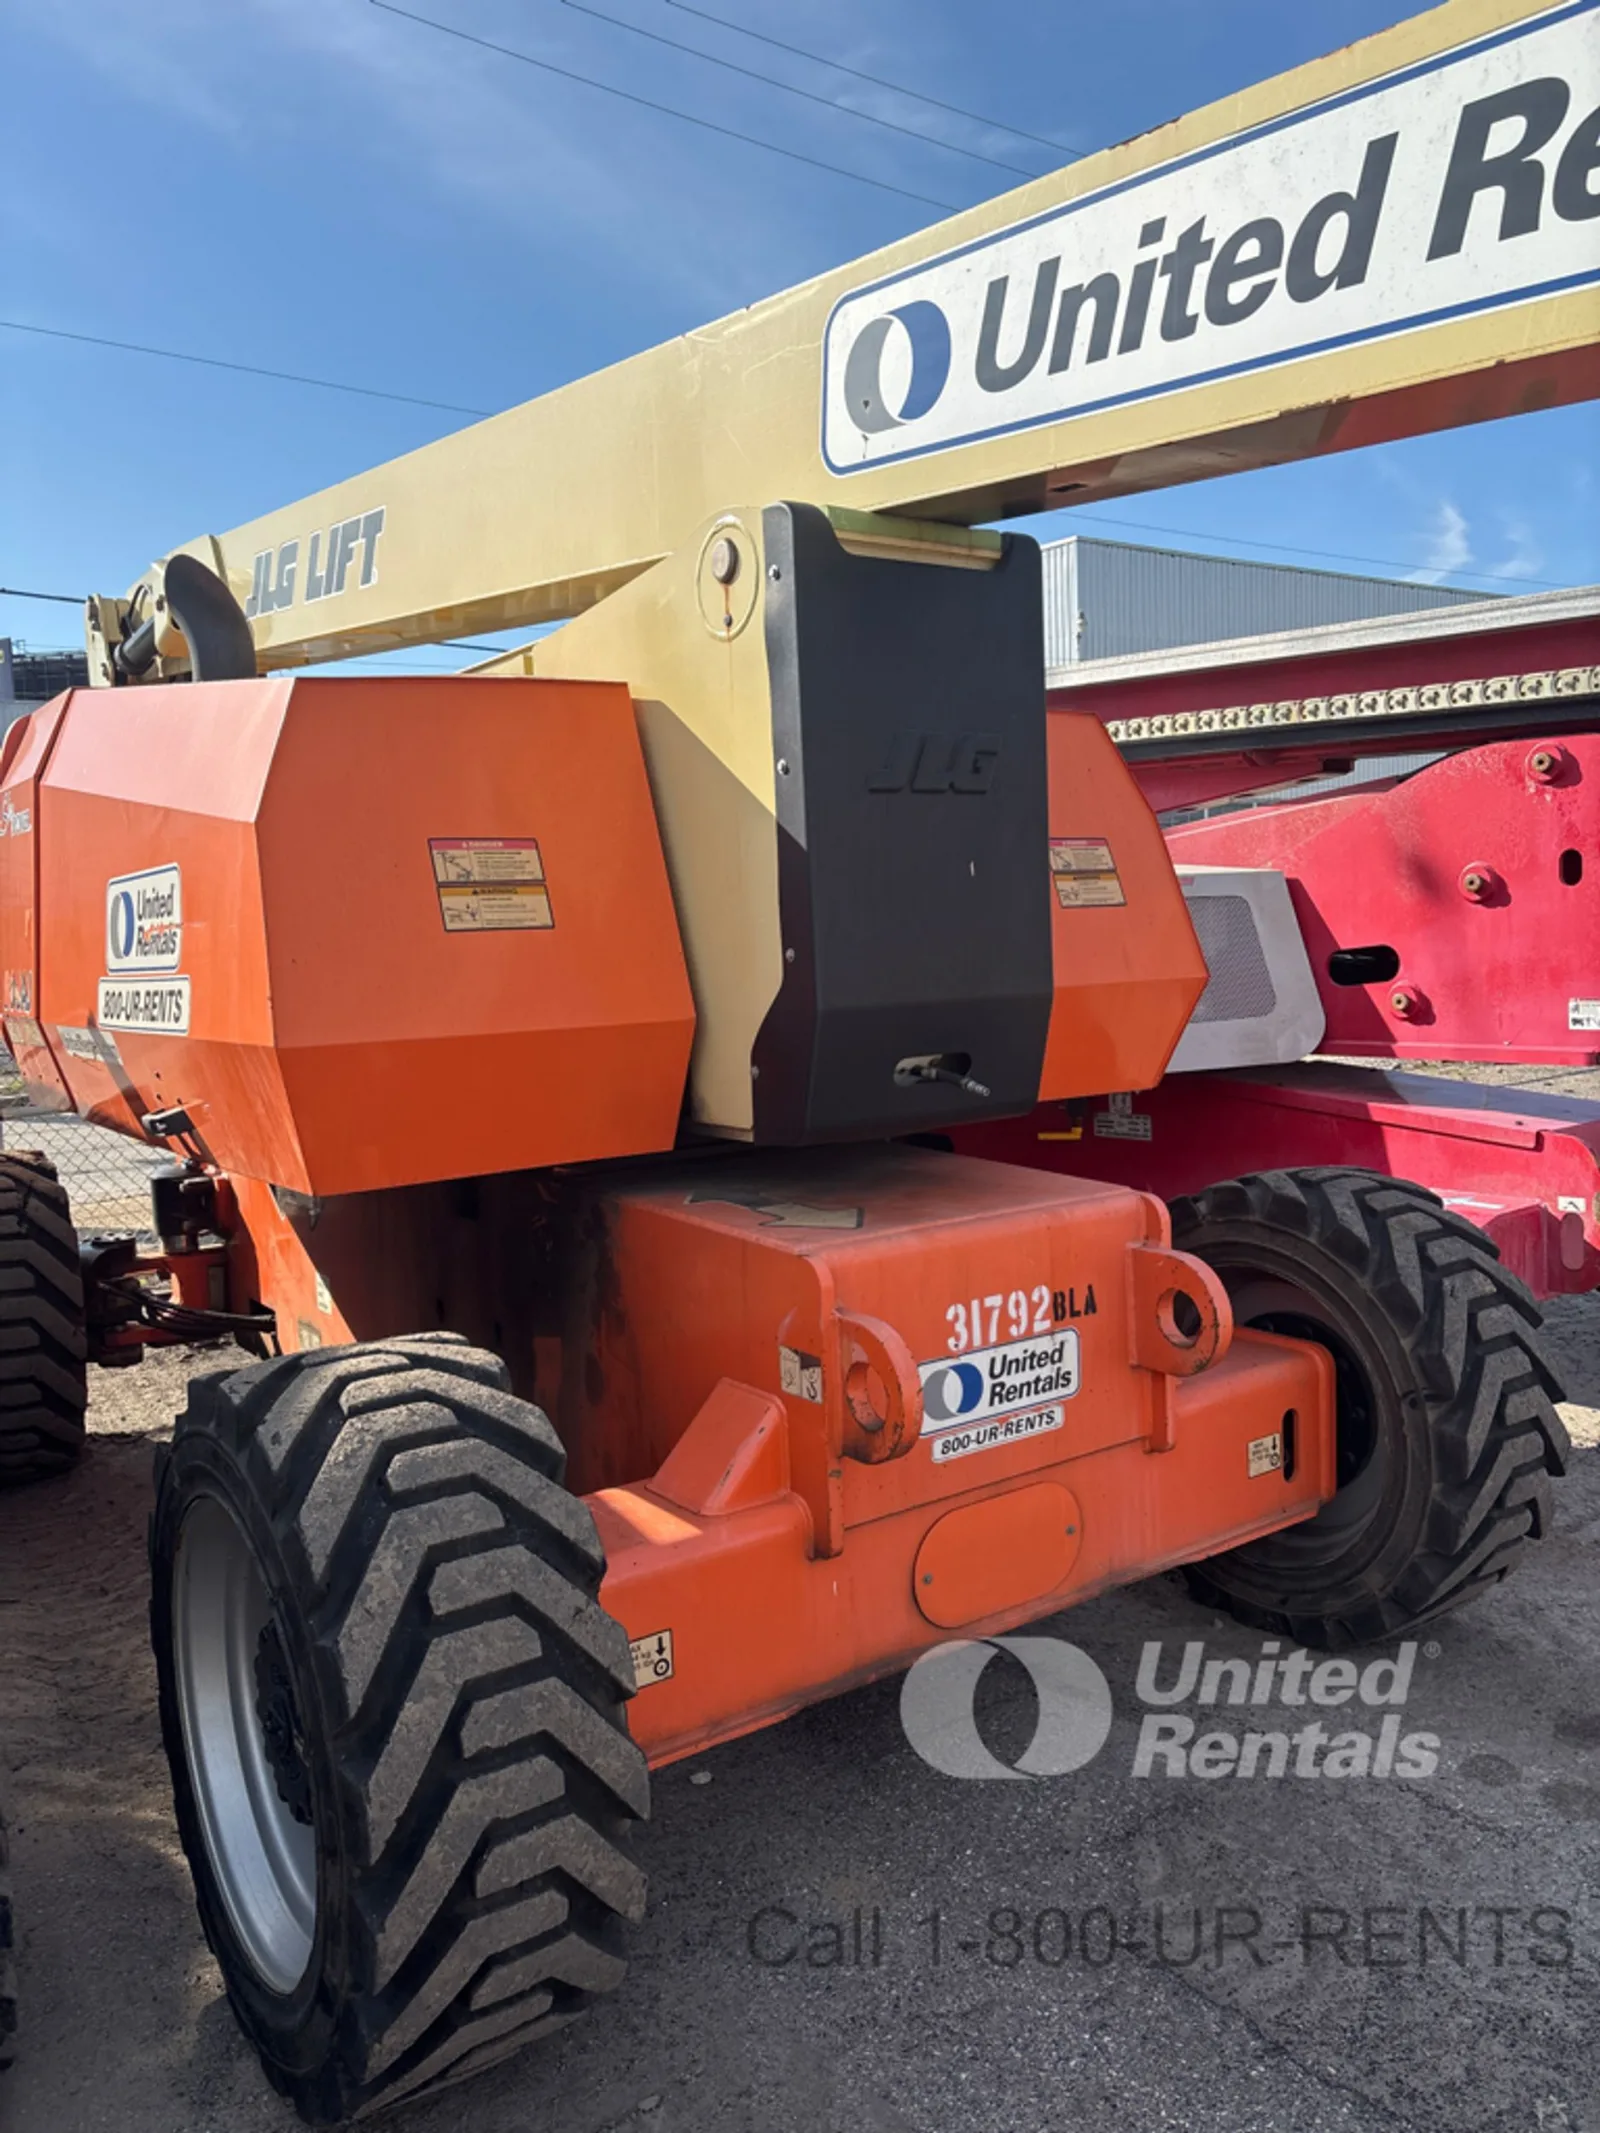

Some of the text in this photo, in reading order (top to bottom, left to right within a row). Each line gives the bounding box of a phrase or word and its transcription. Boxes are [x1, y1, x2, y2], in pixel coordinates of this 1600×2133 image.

[975, 131, 1398, 393] United
[246, 505, 386, 621] JLG LIFT
[866, 729, 1002, 795] JLG
[136, 883, 175, 921] United
[102, 988, 183, 1024] 800-UR-RENTS
[946, 1283, 1097, 1352] 31792 BLA
[988, 1341, 1065, 1380] United
[988, 1366, 1072, 1407] Rentals
[941, 1410, 1055, 1455] 800-UR-RENTS
